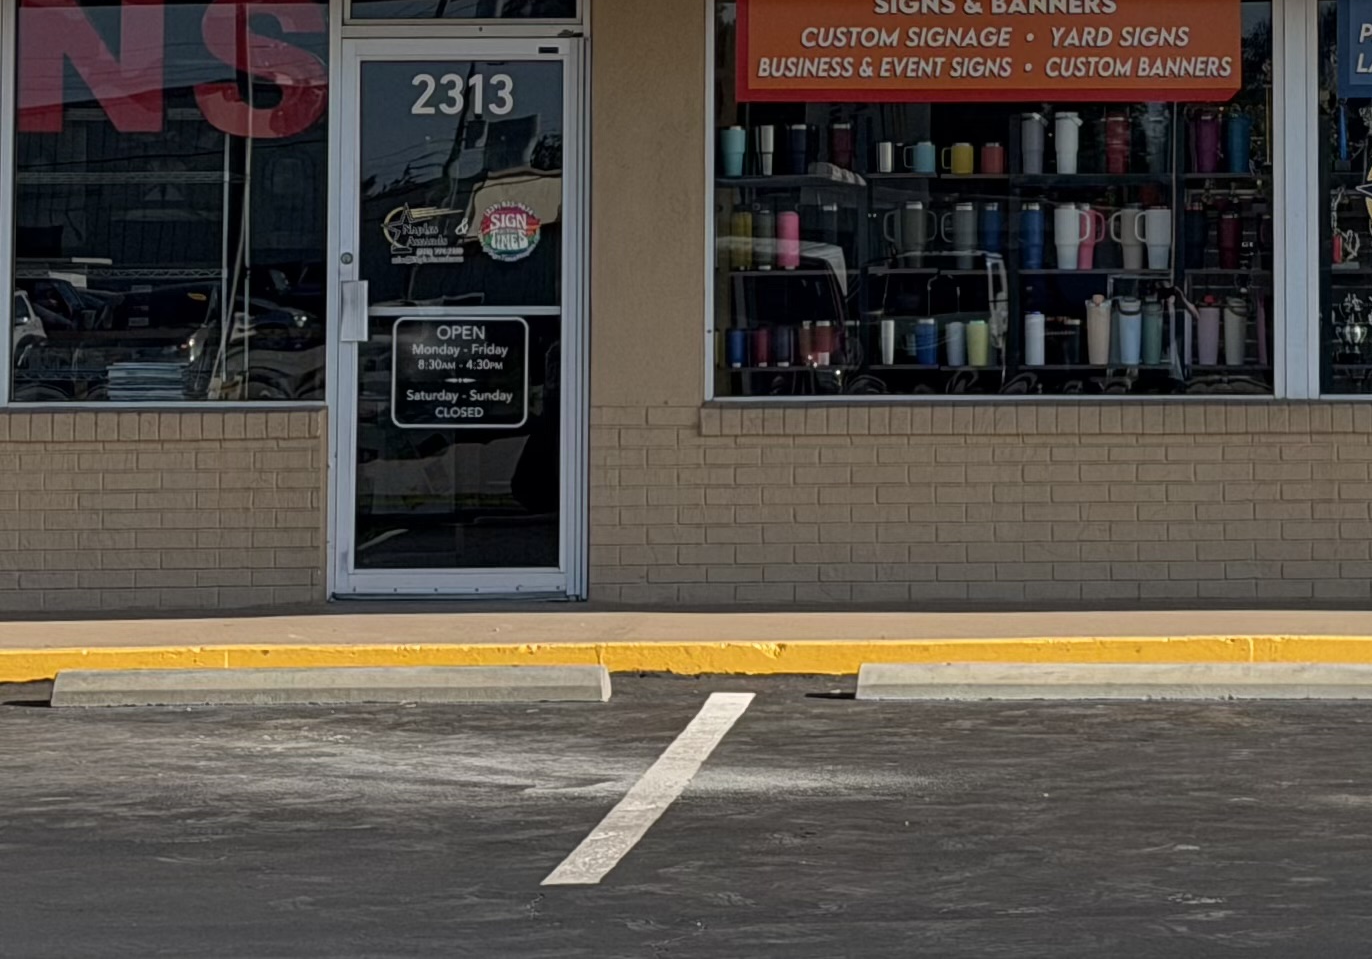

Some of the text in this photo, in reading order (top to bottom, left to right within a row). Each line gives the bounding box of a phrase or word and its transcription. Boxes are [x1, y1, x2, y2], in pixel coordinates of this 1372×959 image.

[801, 26, 1190, 48] CUSTOM SIGNAGE YARD SIGNS
[757, 56, 1232, 78] BUSINESS & EVENT SIGNS CUSTOM BANNERS
[411, 73, 514, 115] 2313
[455, 217, 469, 235] &
[489, 213, 528, 229] SIGN
[436, 325, 486, 340] OPEN
[411, 343, 460, 358] Monday
[471, 342, 509, 358] Friday
[417, 359, 456, 370] 8:30AM
[466, 358, 503, 370] 4:30PM
[406, 389, 459, 404] Saturday
[469, 389, 513, 404] Sunday
[435, 406, 484, 418] CLOSED
